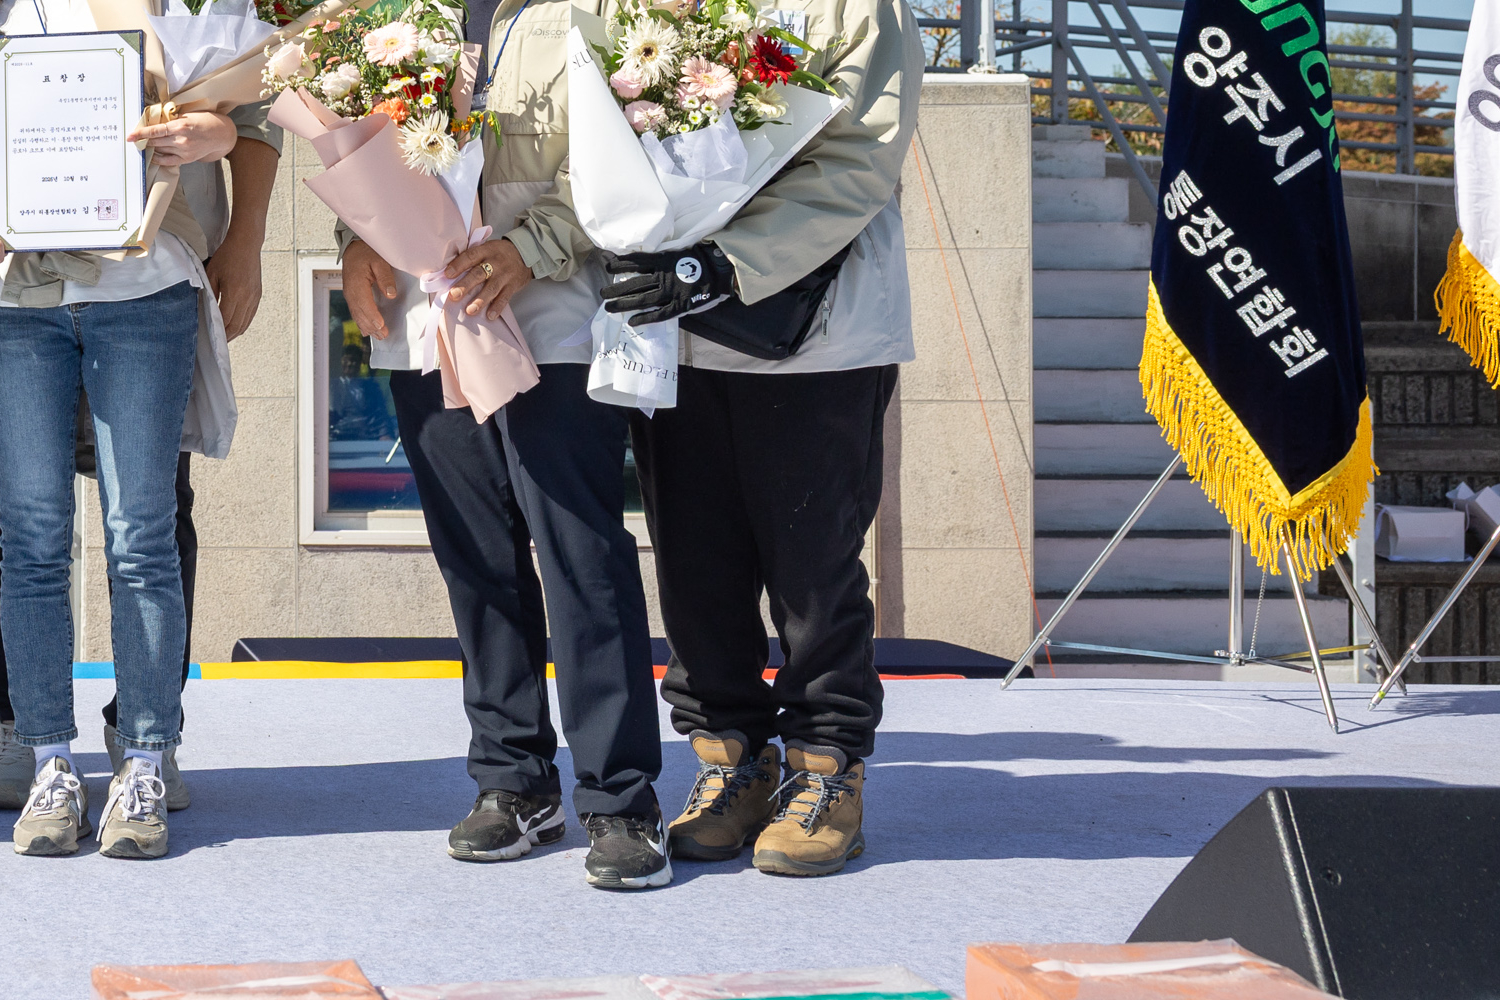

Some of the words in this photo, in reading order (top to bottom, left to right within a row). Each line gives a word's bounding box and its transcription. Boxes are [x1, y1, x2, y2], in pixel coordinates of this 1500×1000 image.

[42, 73, 85, 83] 표창장
[1183, 26, 1323, 186] 양주시
[1163, 170, 1329, 378] 통장연합회
